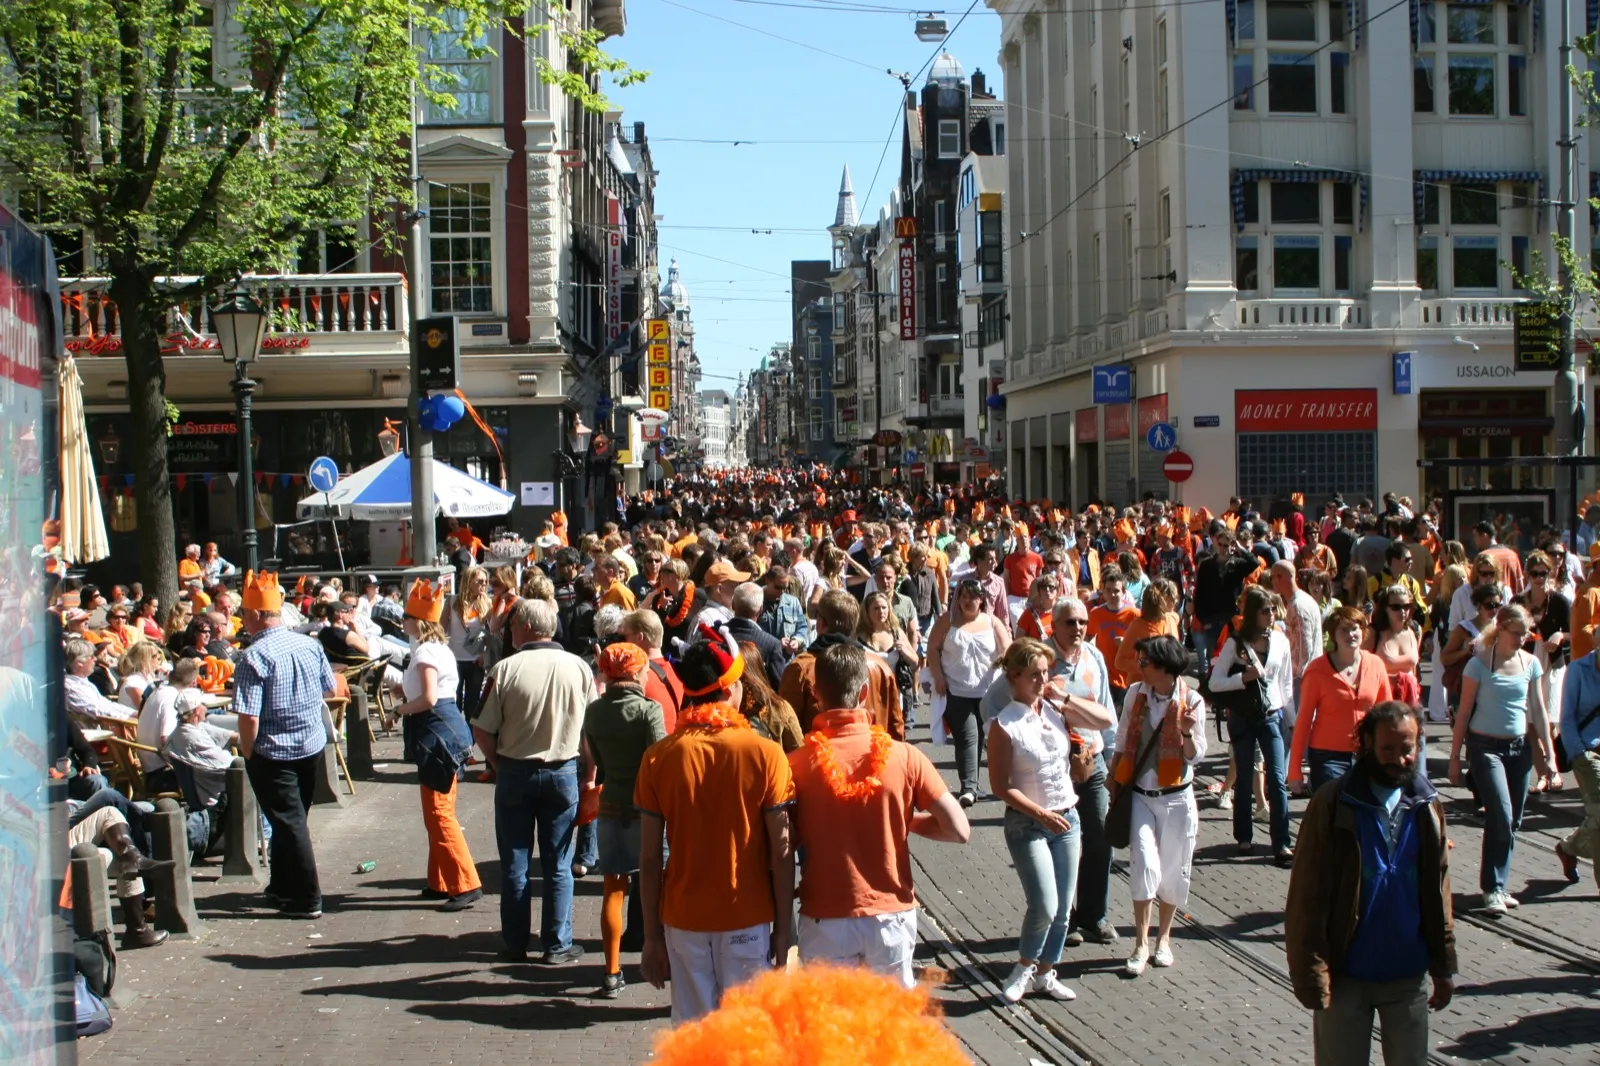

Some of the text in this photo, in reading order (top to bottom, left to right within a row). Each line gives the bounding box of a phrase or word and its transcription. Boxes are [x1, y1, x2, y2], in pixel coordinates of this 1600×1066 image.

[610, 233, 620, 341] GIFTSHO
[901, 247, 913, 338] McDonalds
[1520, 318, 1548, 327] SHOP
[652, 322, 667, 409] FEBO
[1456, 365, 1516, 378] IJSSALON
[1240, 402, 1374, 419] MONEY TRANSFER
[1462, 427, 1511, 437] ICE CREAM
